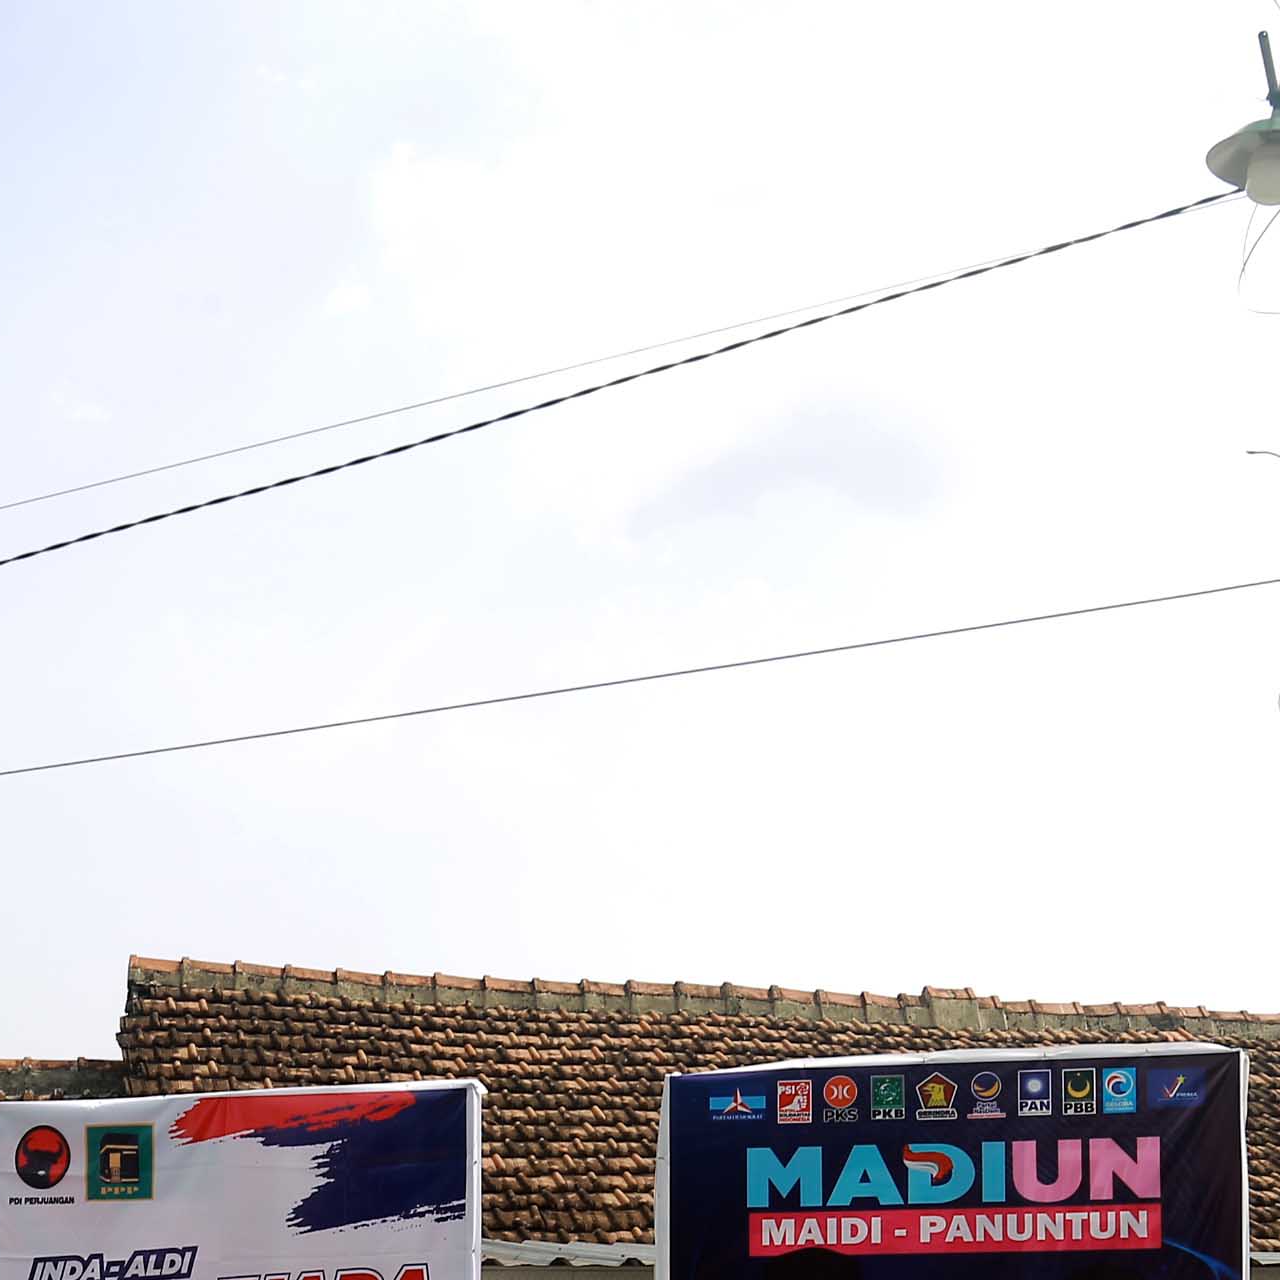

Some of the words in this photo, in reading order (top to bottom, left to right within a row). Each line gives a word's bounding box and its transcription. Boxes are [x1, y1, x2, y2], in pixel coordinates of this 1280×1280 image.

[779, 1085, 795, 1094] PSI
[1019, 1100, 1051, 1112] PAN
[1063, 1102, 1095, 1114] PBB
[823, 1108, 859, 1122] PKS
[872, 1109, 905, 1119] PKB
[746, 1136, 1161, 1208] MADIUN
[9, 1197, 23, 1205] PDI
[24, 1196, 75, 1206] PERJUANGAN
[761, 1216, 882, 1247] MAIDI
[920, 1210, 1150, 1244] PANUNTUN
